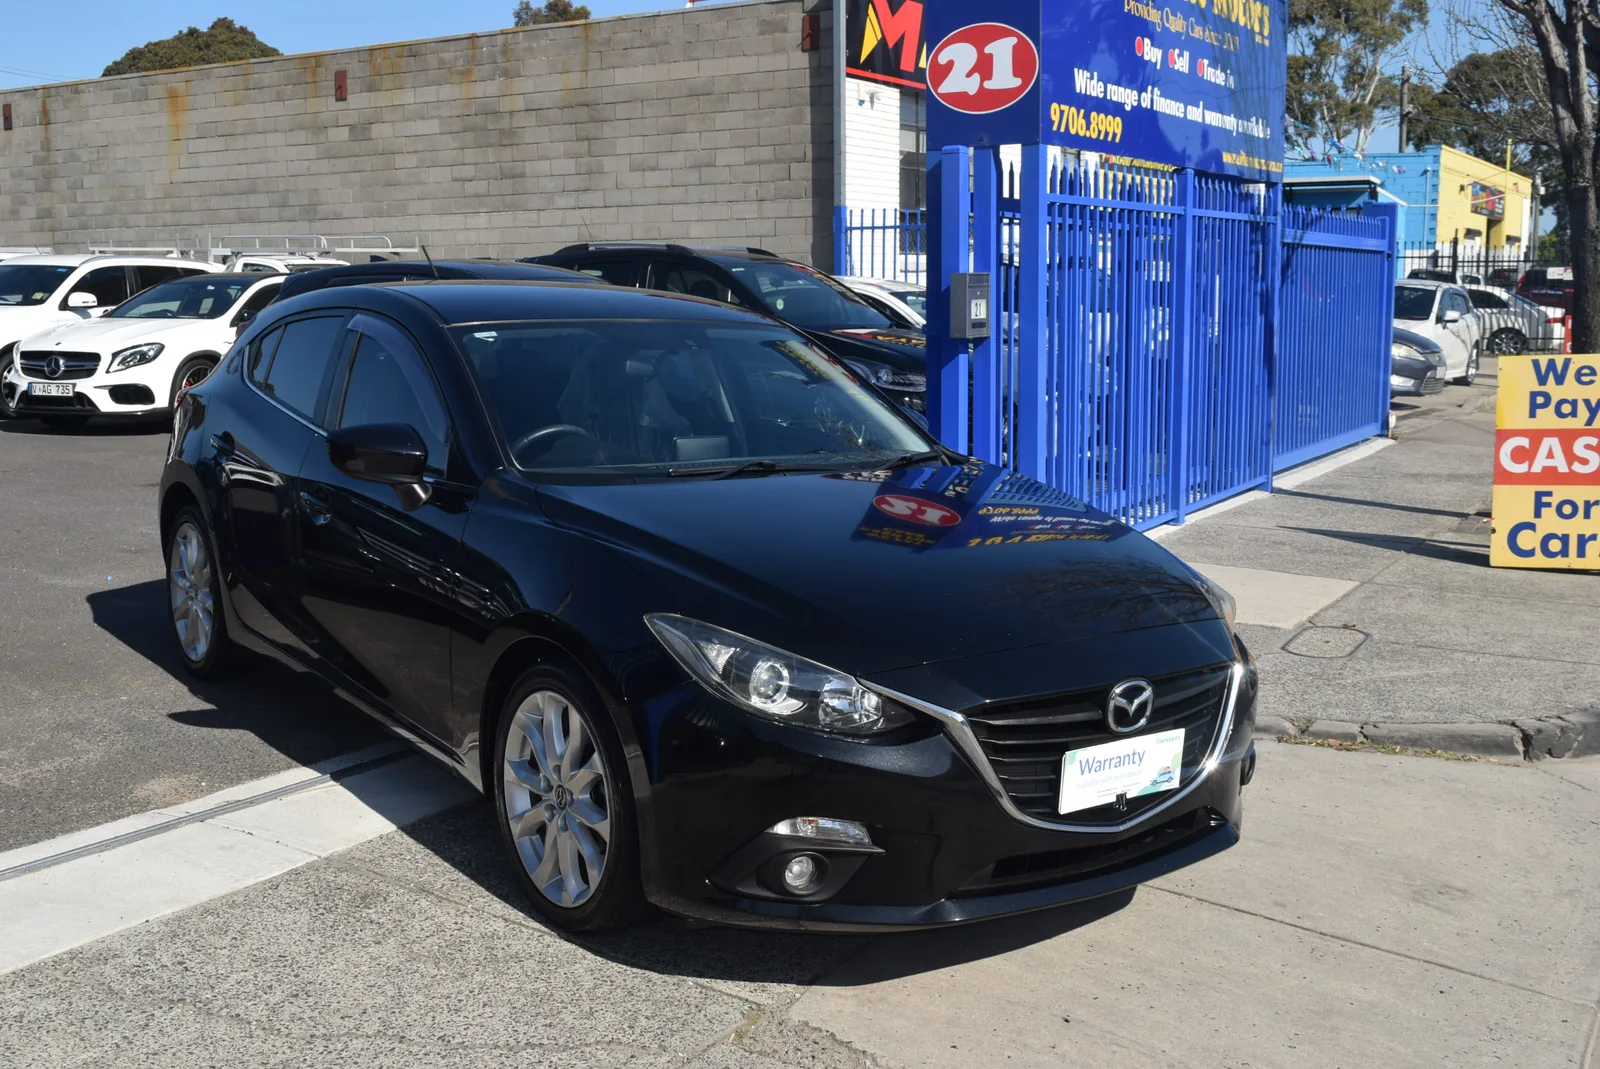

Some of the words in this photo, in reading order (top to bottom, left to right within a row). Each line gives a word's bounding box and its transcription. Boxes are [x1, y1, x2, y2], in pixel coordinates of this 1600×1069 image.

[1124, 0, 1162, 32] Providing
[1163, 8, 1187, 40] Quality
[1188, 17, 1204, 41] Cars
[938, 36, 1022, 96] 21
[1143, 38, 1162, 69] Buy
[1173, 48, 1190, 74] Sell
[1202, 58, 1226, 86] Trade
[1226, 70, 1235, 89] in
[1073, 67, 1104, 98] Wide
[1106, 83, 1138, 111] range
[1140, 85, 1152, 109] of
[1152, 87, 1185, 118] finance
[1186, 101, 1203, 123] and
[1204, 109, 1238, 136] warranty
[1050, 102, 1122, 143] 9706.8999
[974, 302, 982, 317] 21
[55, 385, 70, 395] 735
[1531, 357, 1599, 387] We
[1528, 390, 1600, 427] Pay
[1533, 490, 1600, 520] For
[1507, 521, 1600, 559] Car
[1079, 748, 1146, 776] Warranty
